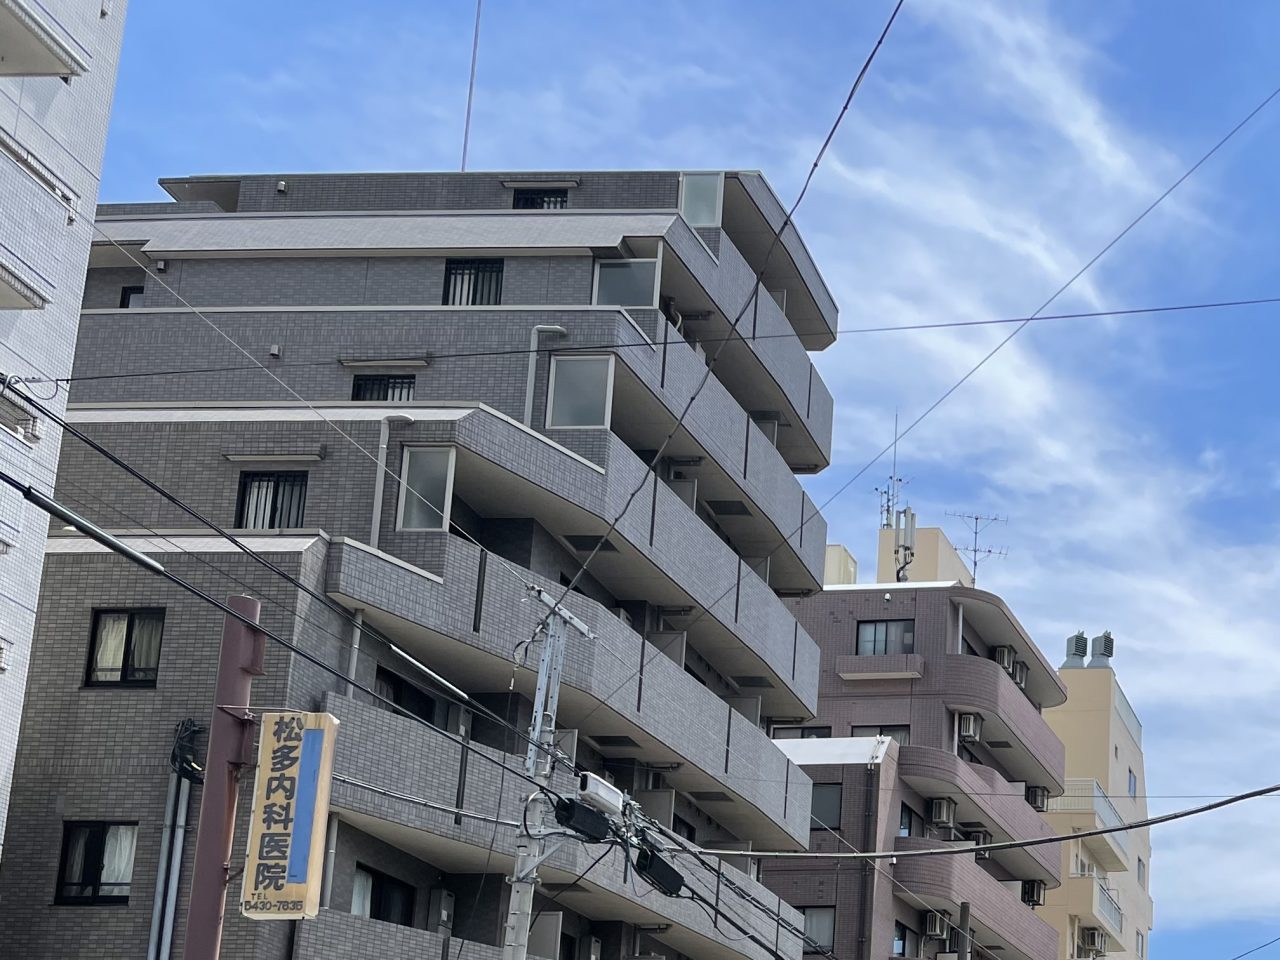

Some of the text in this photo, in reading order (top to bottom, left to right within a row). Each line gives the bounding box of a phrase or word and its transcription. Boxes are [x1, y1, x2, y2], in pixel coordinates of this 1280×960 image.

[253, 715, 305, 892] 松多内科医院
[251, 892, 269, 900] TEL
